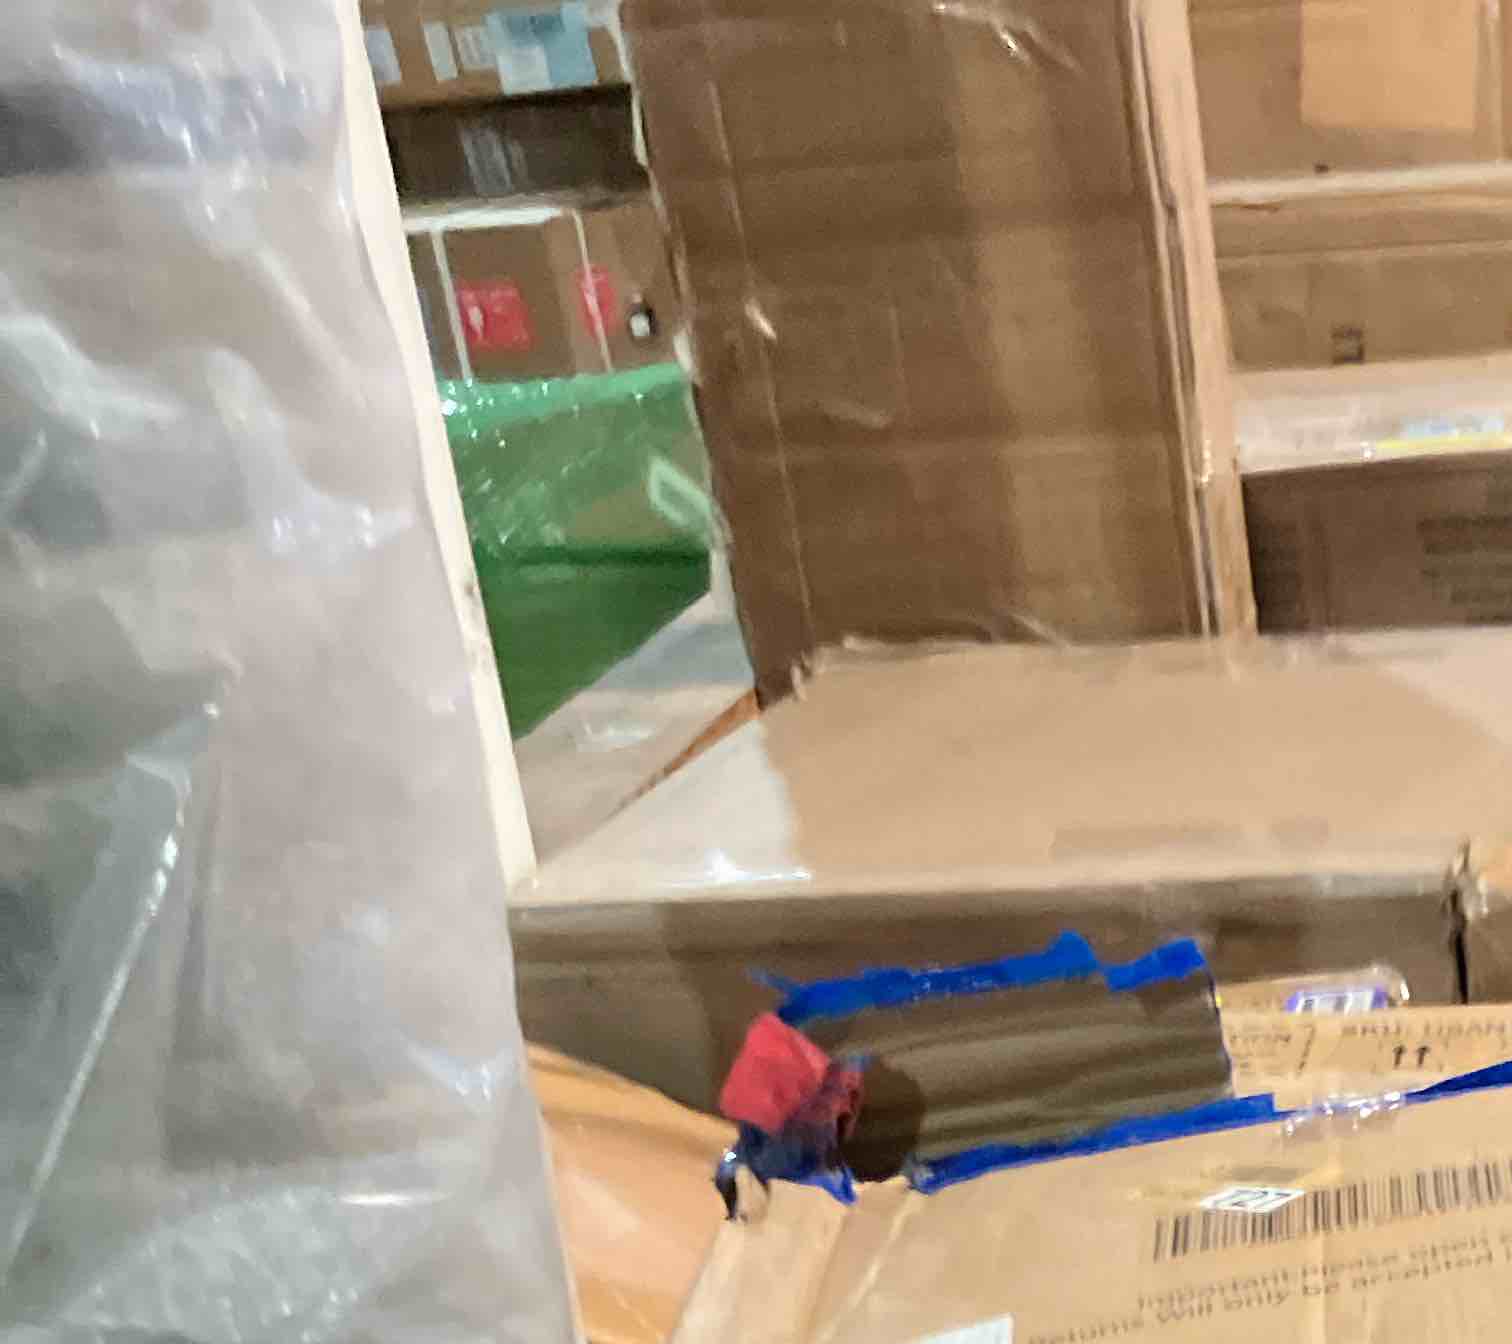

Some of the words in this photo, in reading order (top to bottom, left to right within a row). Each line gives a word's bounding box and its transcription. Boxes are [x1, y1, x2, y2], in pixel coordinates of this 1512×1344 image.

[1223, 1285, 1290, 1315] only
[1302, 1278, 1341, 1298] be
[1352, 1251, 1494, 1290] accepted
